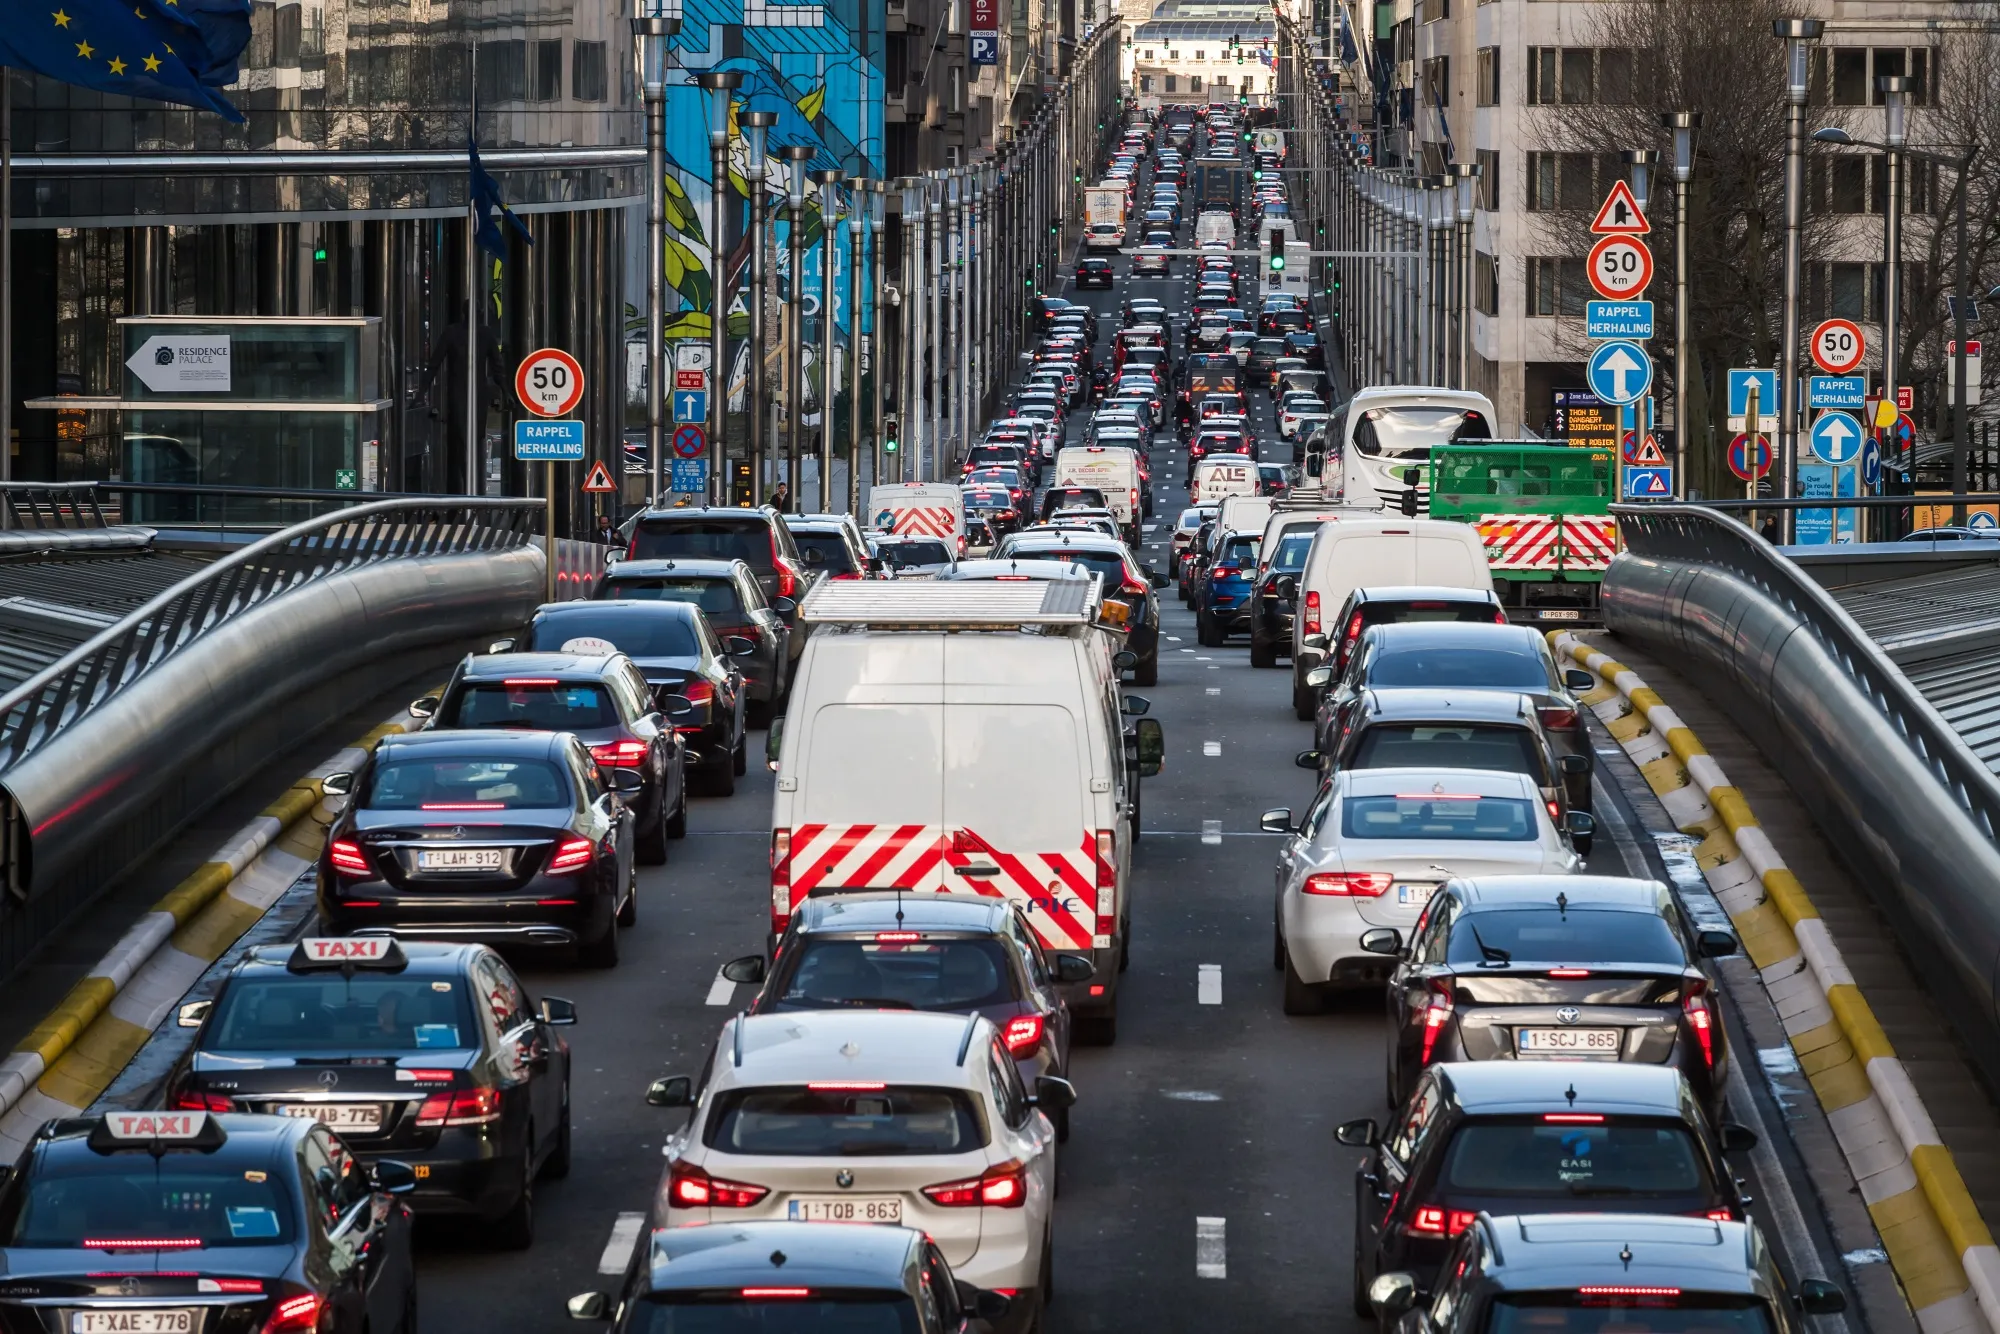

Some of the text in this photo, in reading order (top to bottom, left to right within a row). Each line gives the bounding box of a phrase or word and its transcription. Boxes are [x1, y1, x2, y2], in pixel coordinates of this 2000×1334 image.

[973, 39, 988, 58] P
[1604, 252, 1636, 273] 50
[1612, 276, 1628, 285] km
[1597, 307, 1642, 317] RAPPEL
[1589, 323, 1651, 333] HERHALING
[1825, 333, 1852, 351] 50
[179, 348, 228, 356] RESIDENCE
[179, 356, 213, 364] PALACE
[533, 367, 566, 389] 50
[1819, 381, 1855, 390] RAPPEL
[541, 392, 558, 401] km
[1555, 393, 1564, 403] P
[1812, 395, 1863, 404] HERHALING
[526, 427, 572, 437] RAPPEL
[518, 443, 582, 454] HERHALING
[575, 639, 604, 648] TAXI
[314, 941, 377, 956] TAXI
[1531, 1033, 1615, 1047] 1-SCJ-865
[118, 1117, 191, 1134] TAXI
[1560, 1159, 1592, 1168] EASI
